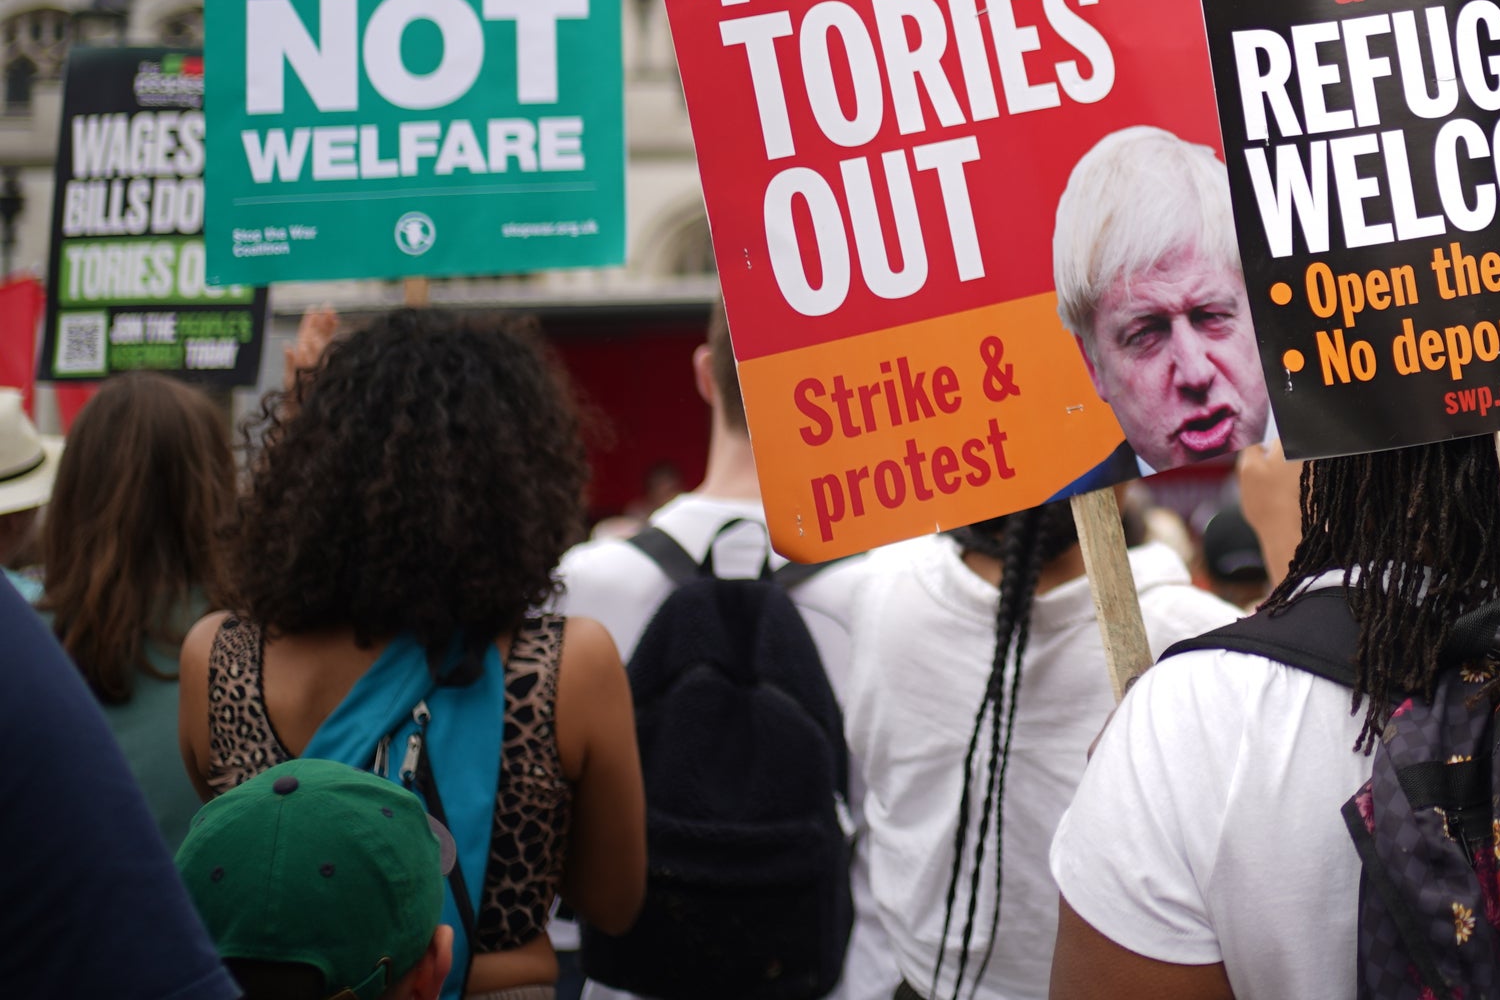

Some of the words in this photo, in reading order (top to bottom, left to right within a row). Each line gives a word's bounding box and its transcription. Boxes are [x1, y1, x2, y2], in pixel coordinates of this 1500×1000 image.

[72, 111, 205, 179] WAGES
[242, 117, 584, 183] WELFARE
[64, 178, 149, 236] BILLS
[152, 177, 205, 234] DO
[264, 226, 288, 241] the
[764, 136, 985, 317] OUT
[66, 240, 175, 301] TORIES
[1305, 262, 1419, 328] Open
[1317, 329, 1376, 385] No
[793, 357, 962, 447] Strike
[980, 335, 1021, 403] &
[810, 418, 1016, 543] protest
